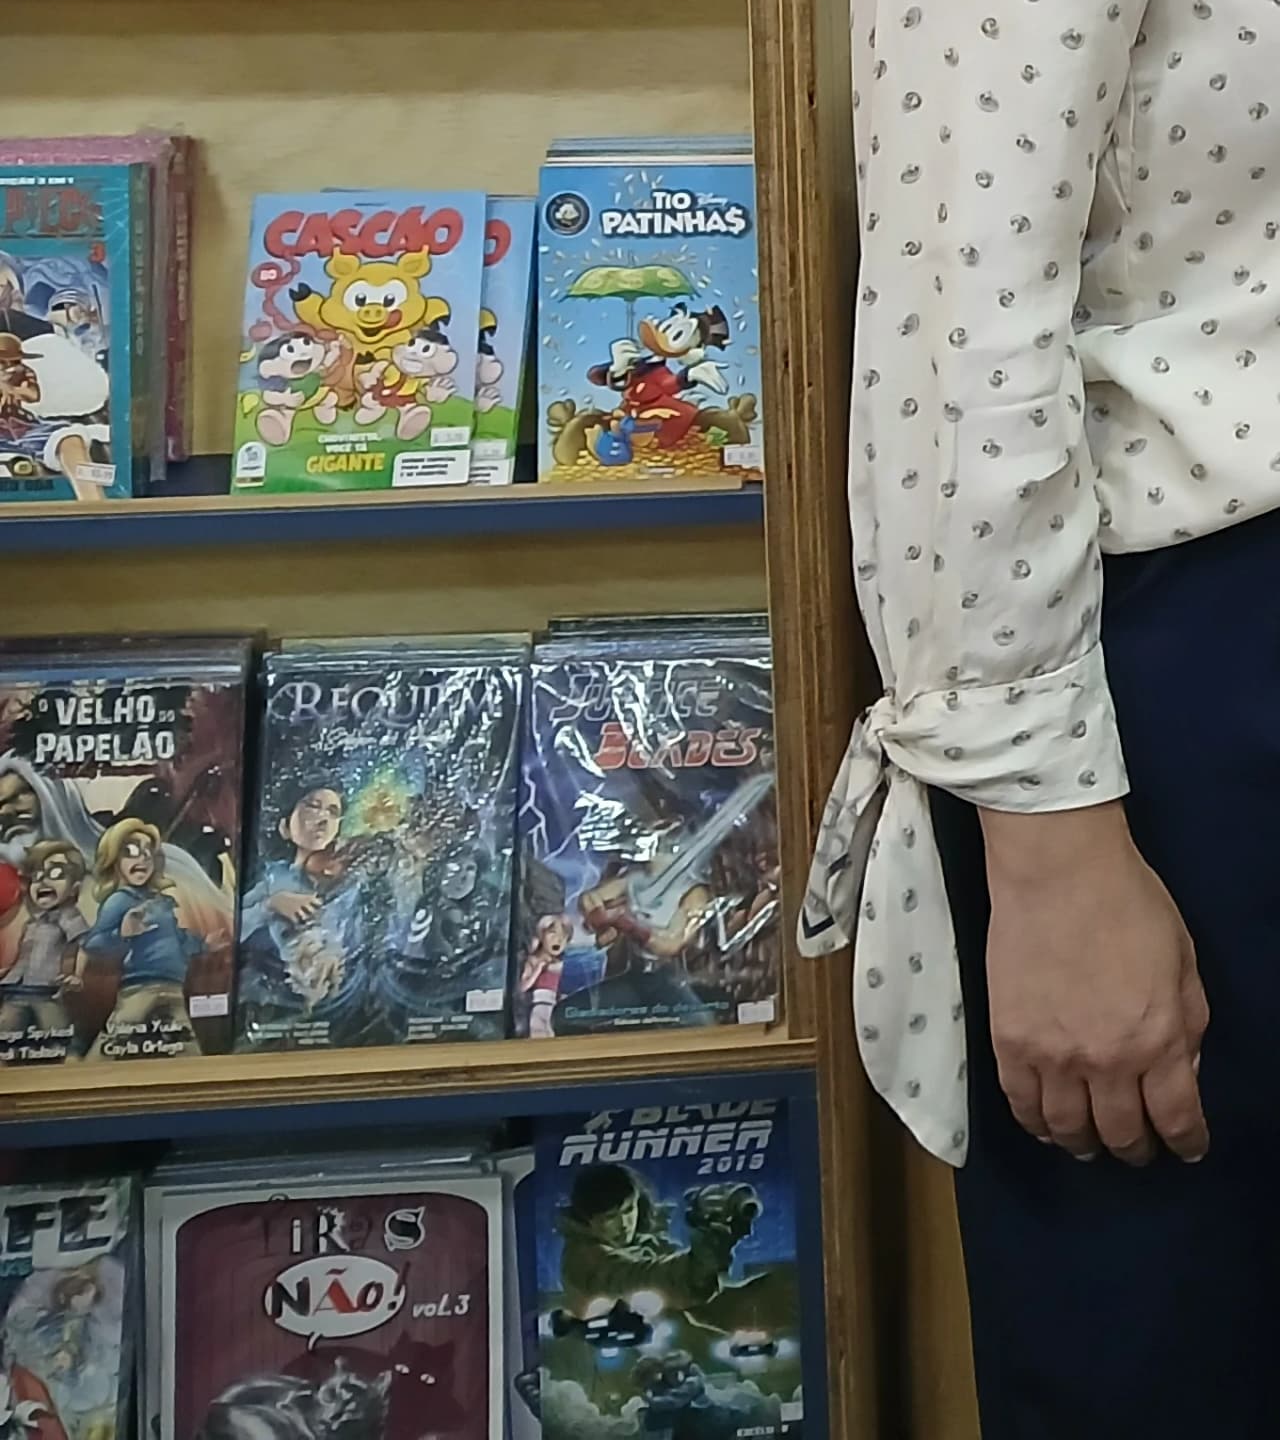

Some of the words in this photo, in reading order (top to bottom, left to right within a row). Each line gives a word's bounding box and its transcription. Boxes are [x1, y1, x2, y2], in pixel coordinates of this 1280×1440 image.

[652, 191, 691, 210] TIO
[306, 452, 386, 473] GIGANTE
[55, 694, 156, 726] VELHO
[34, 724, 176, 764] PAPELÃO
[559, 1119, 774, 1167] RUNNER
[272, 1262, 412, 1318] NÃO!
